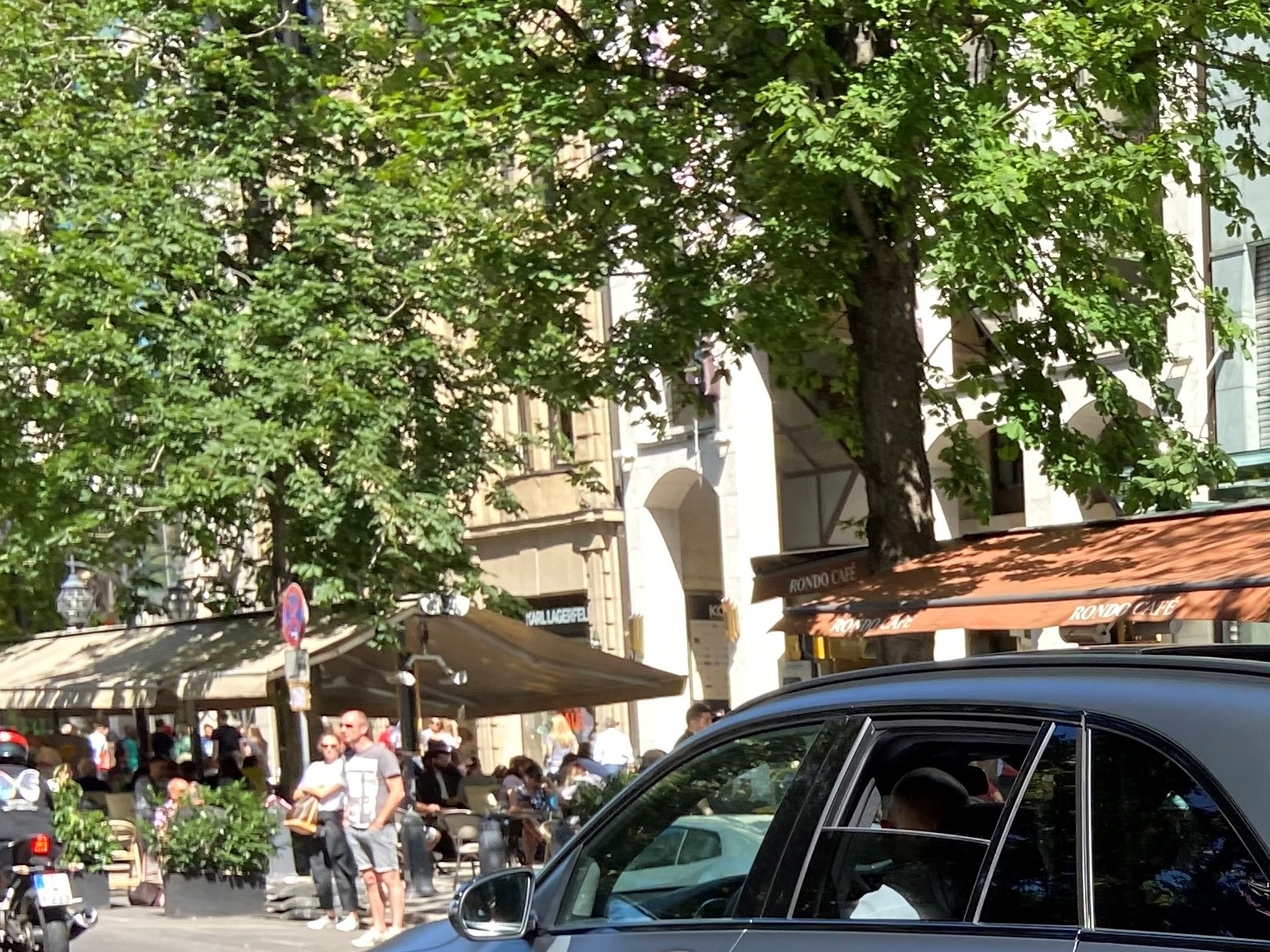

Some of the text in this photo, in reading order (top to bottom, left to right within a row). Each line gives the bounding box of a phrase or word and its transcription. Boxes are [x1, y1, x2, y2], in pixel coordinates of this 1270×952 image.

[789, 562, 857, 594] RONDO CAFÉ
[1068, 595, 1181, 621] RONDO CAFÉ
[830, 616, 881, 633] RONDO
